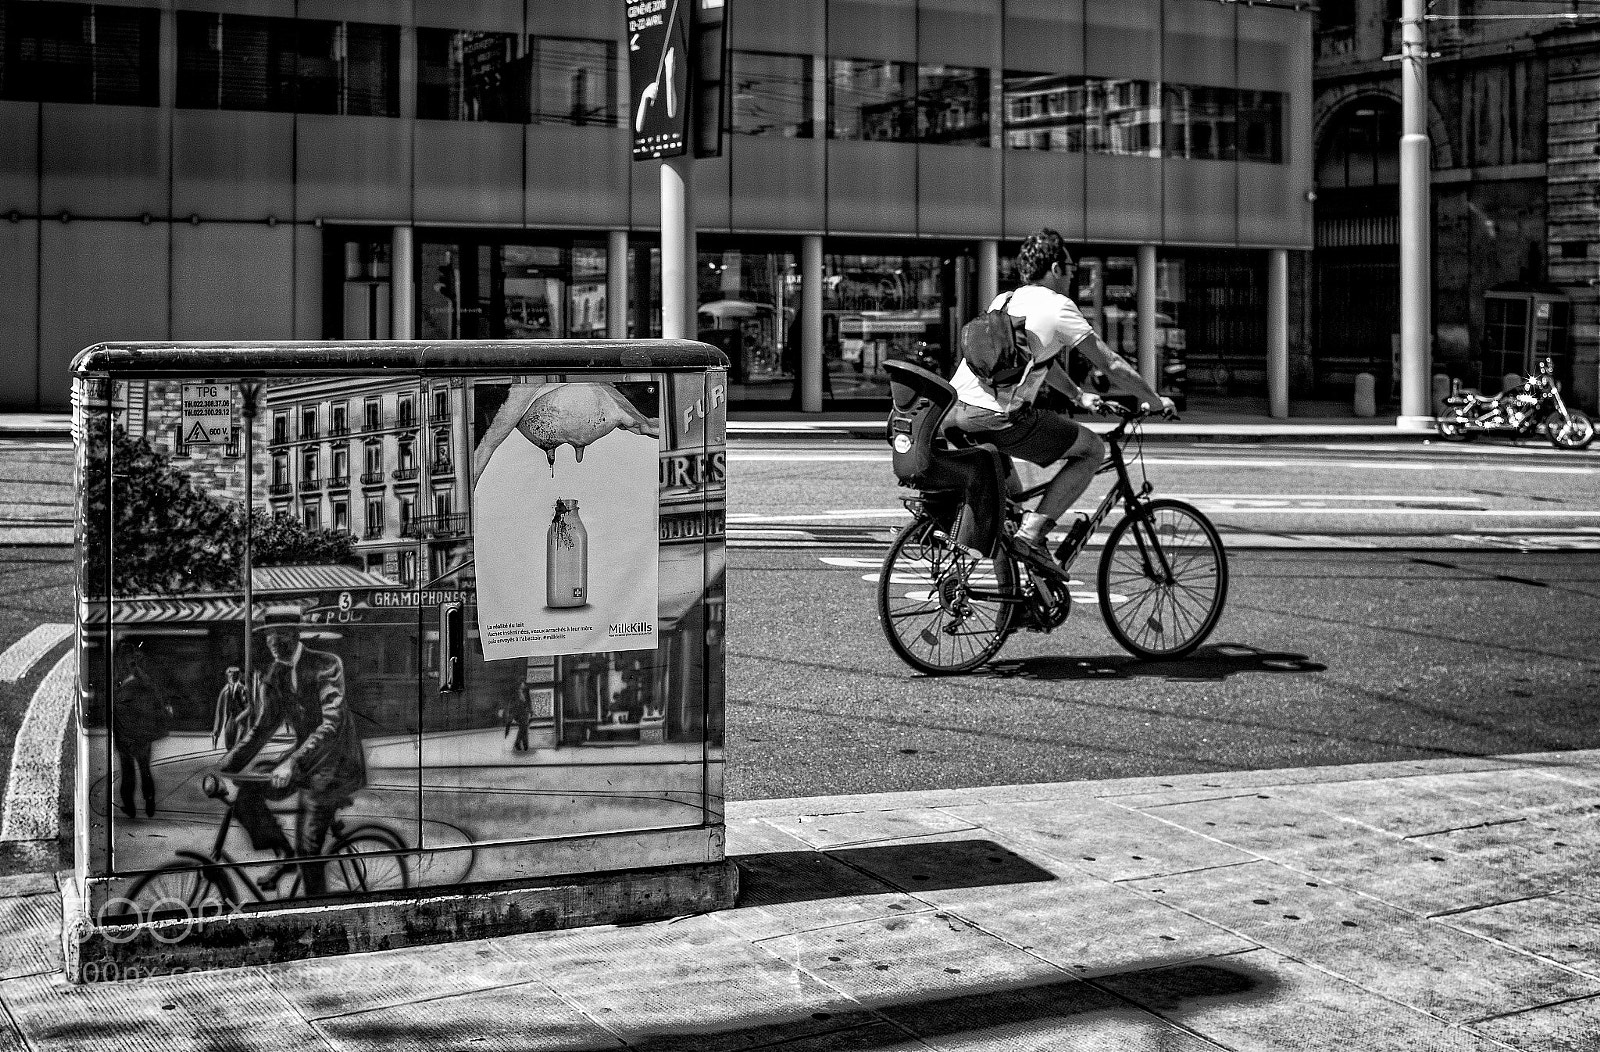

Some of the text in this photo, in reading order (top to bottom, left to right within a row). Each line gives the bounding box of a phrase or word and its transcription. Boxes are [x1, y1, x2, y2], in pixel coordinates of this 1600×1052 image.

[196, 386, 218, 398] TPG
[209, 428, 221, 436] 600
[341, 594, 350, 610] 3
[374, 590, 467, 606] GRAMOPHONES
[608, 622, 653, 634] MilkKills
